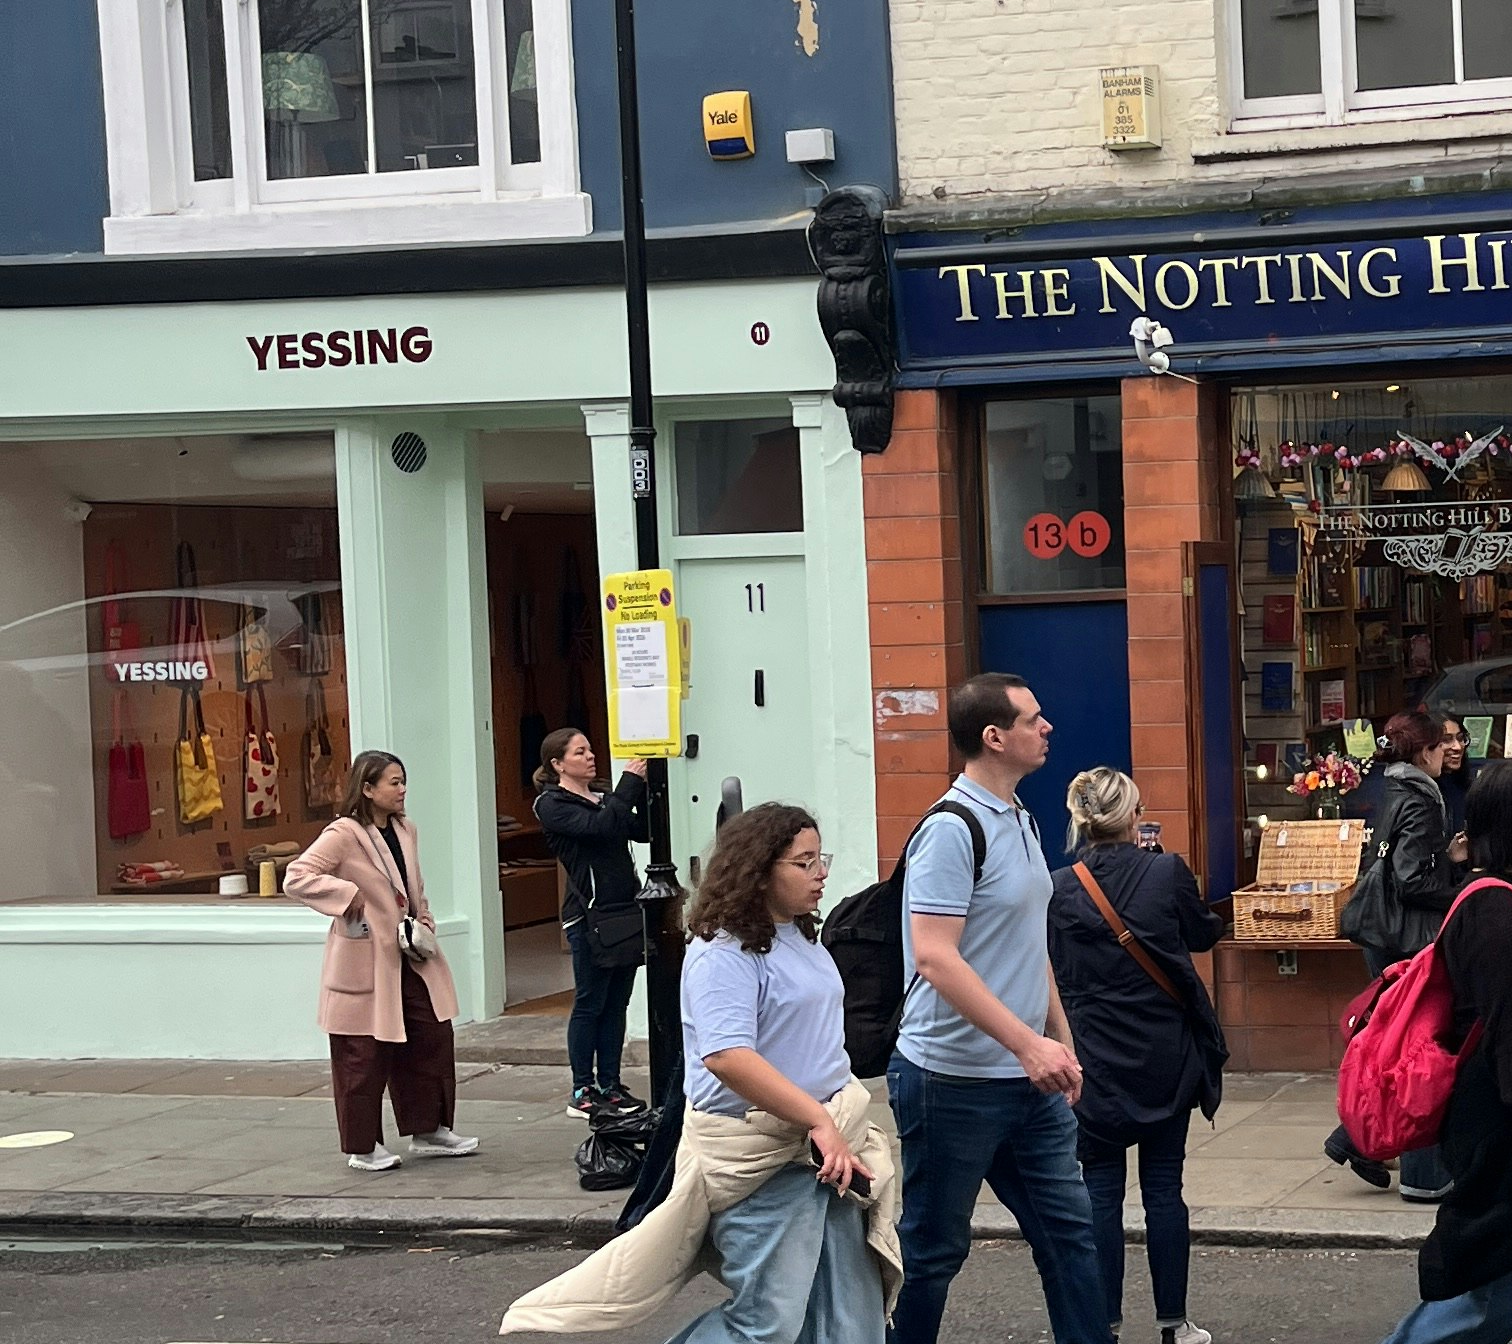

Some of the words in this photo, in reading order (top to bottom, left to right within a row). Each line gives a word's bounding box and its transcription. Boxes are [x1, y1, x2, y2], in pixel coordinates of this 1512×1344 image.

[1103, 77, 1142, 88] BANHAM
[1104, 87, 1142, 98] ALARMS
[1117, 105, 1130, 115] 01
[708, 110, 738, 125] Yale
[1115, 115, 1133, 124] 385
[1113, 125, 1136, 135] 3322
[939, 263, 1076, 322] THE
[1091, 246, 1404, 314] NOTTING
[246, 326, 433, 371] YESSING
[1317, 513, 1353, 532] THE
[1357, 511, 1445, 530] NOTTING
[1448, 508, 1492, 526] HILL
[623, 580, 651, 591] Parking
[618, 593, 658, 606] Suspension
[745, 582, 765, 613] 11
[620, 611, 630, 621] No
[631, 609, 658, 621] Loading
[114, 660, 209, 682] YESSING
